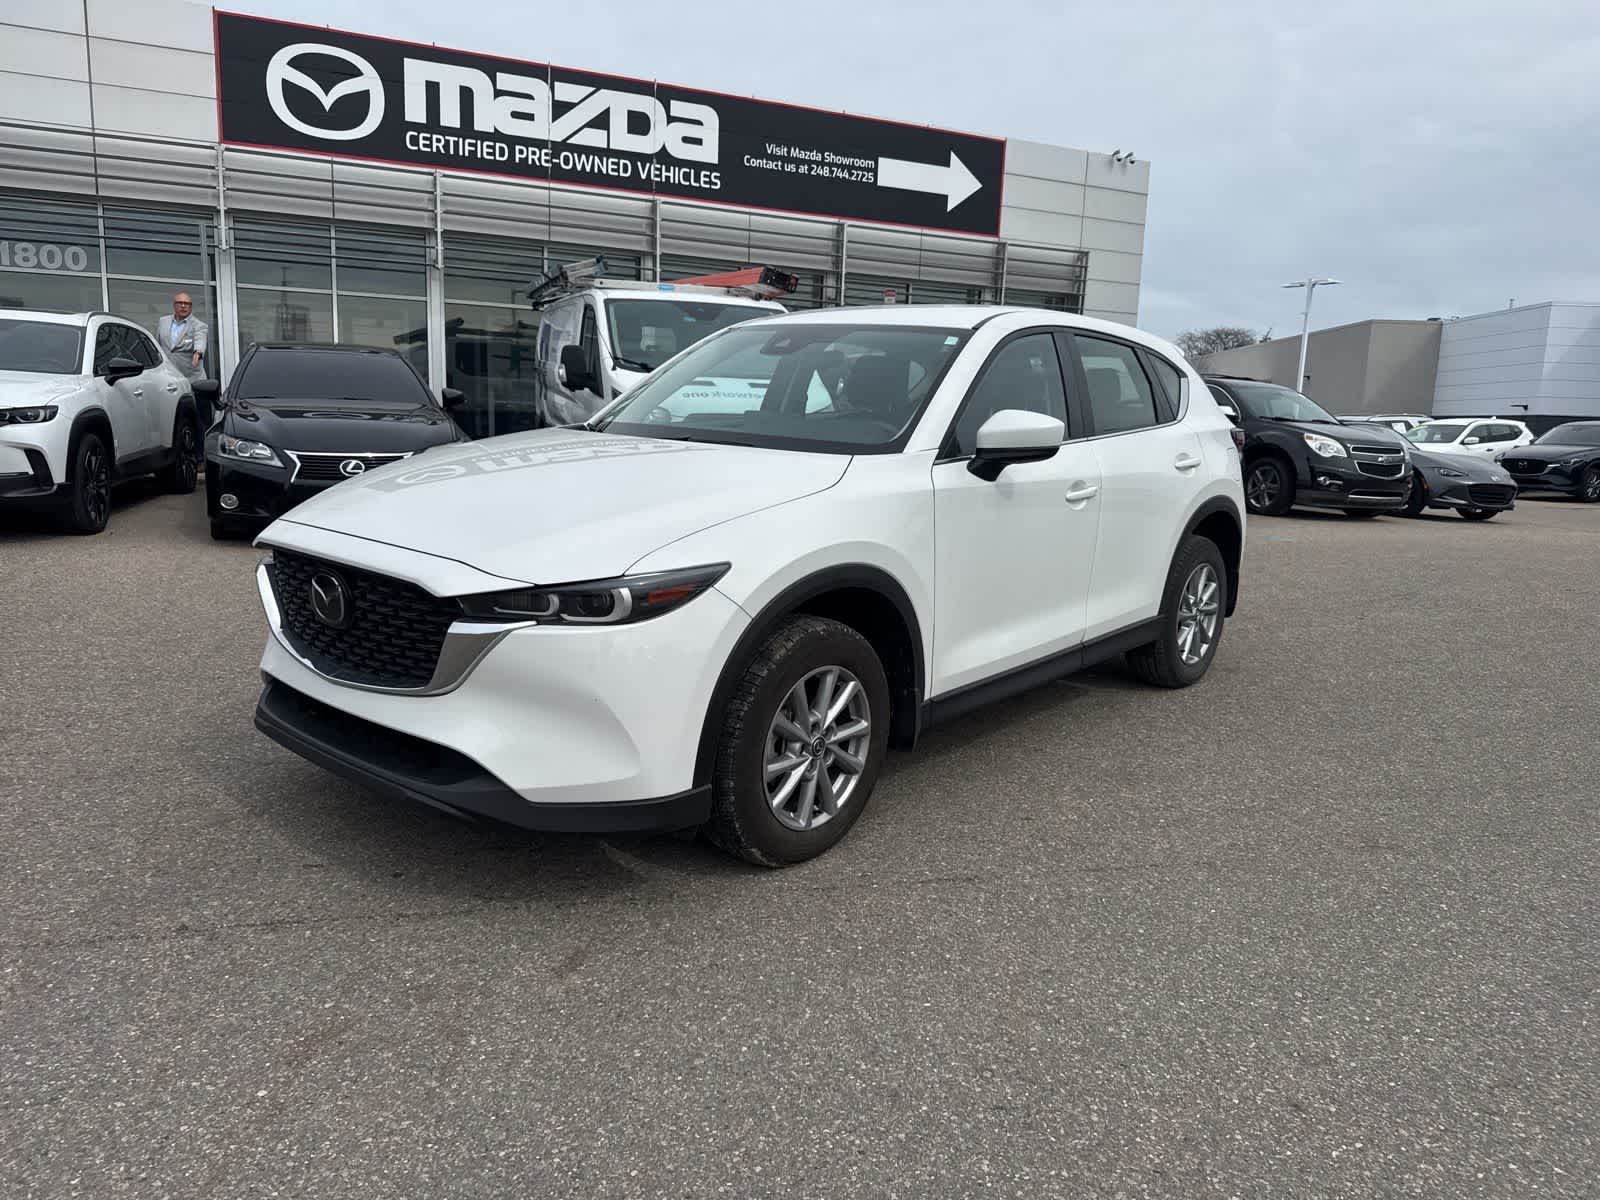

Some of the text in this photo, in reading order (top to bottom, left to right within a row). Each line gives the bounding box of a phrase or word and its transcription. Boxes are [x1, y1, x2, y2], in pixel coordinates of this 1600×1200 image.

[405, 131, 721, 189] CERTIFIED PRE-OWNED VEHICLES
[743, 155, 874, 182] Contact us at 248.744.2725
[766, 143, 875, 168] Visit Mazda Showroom
